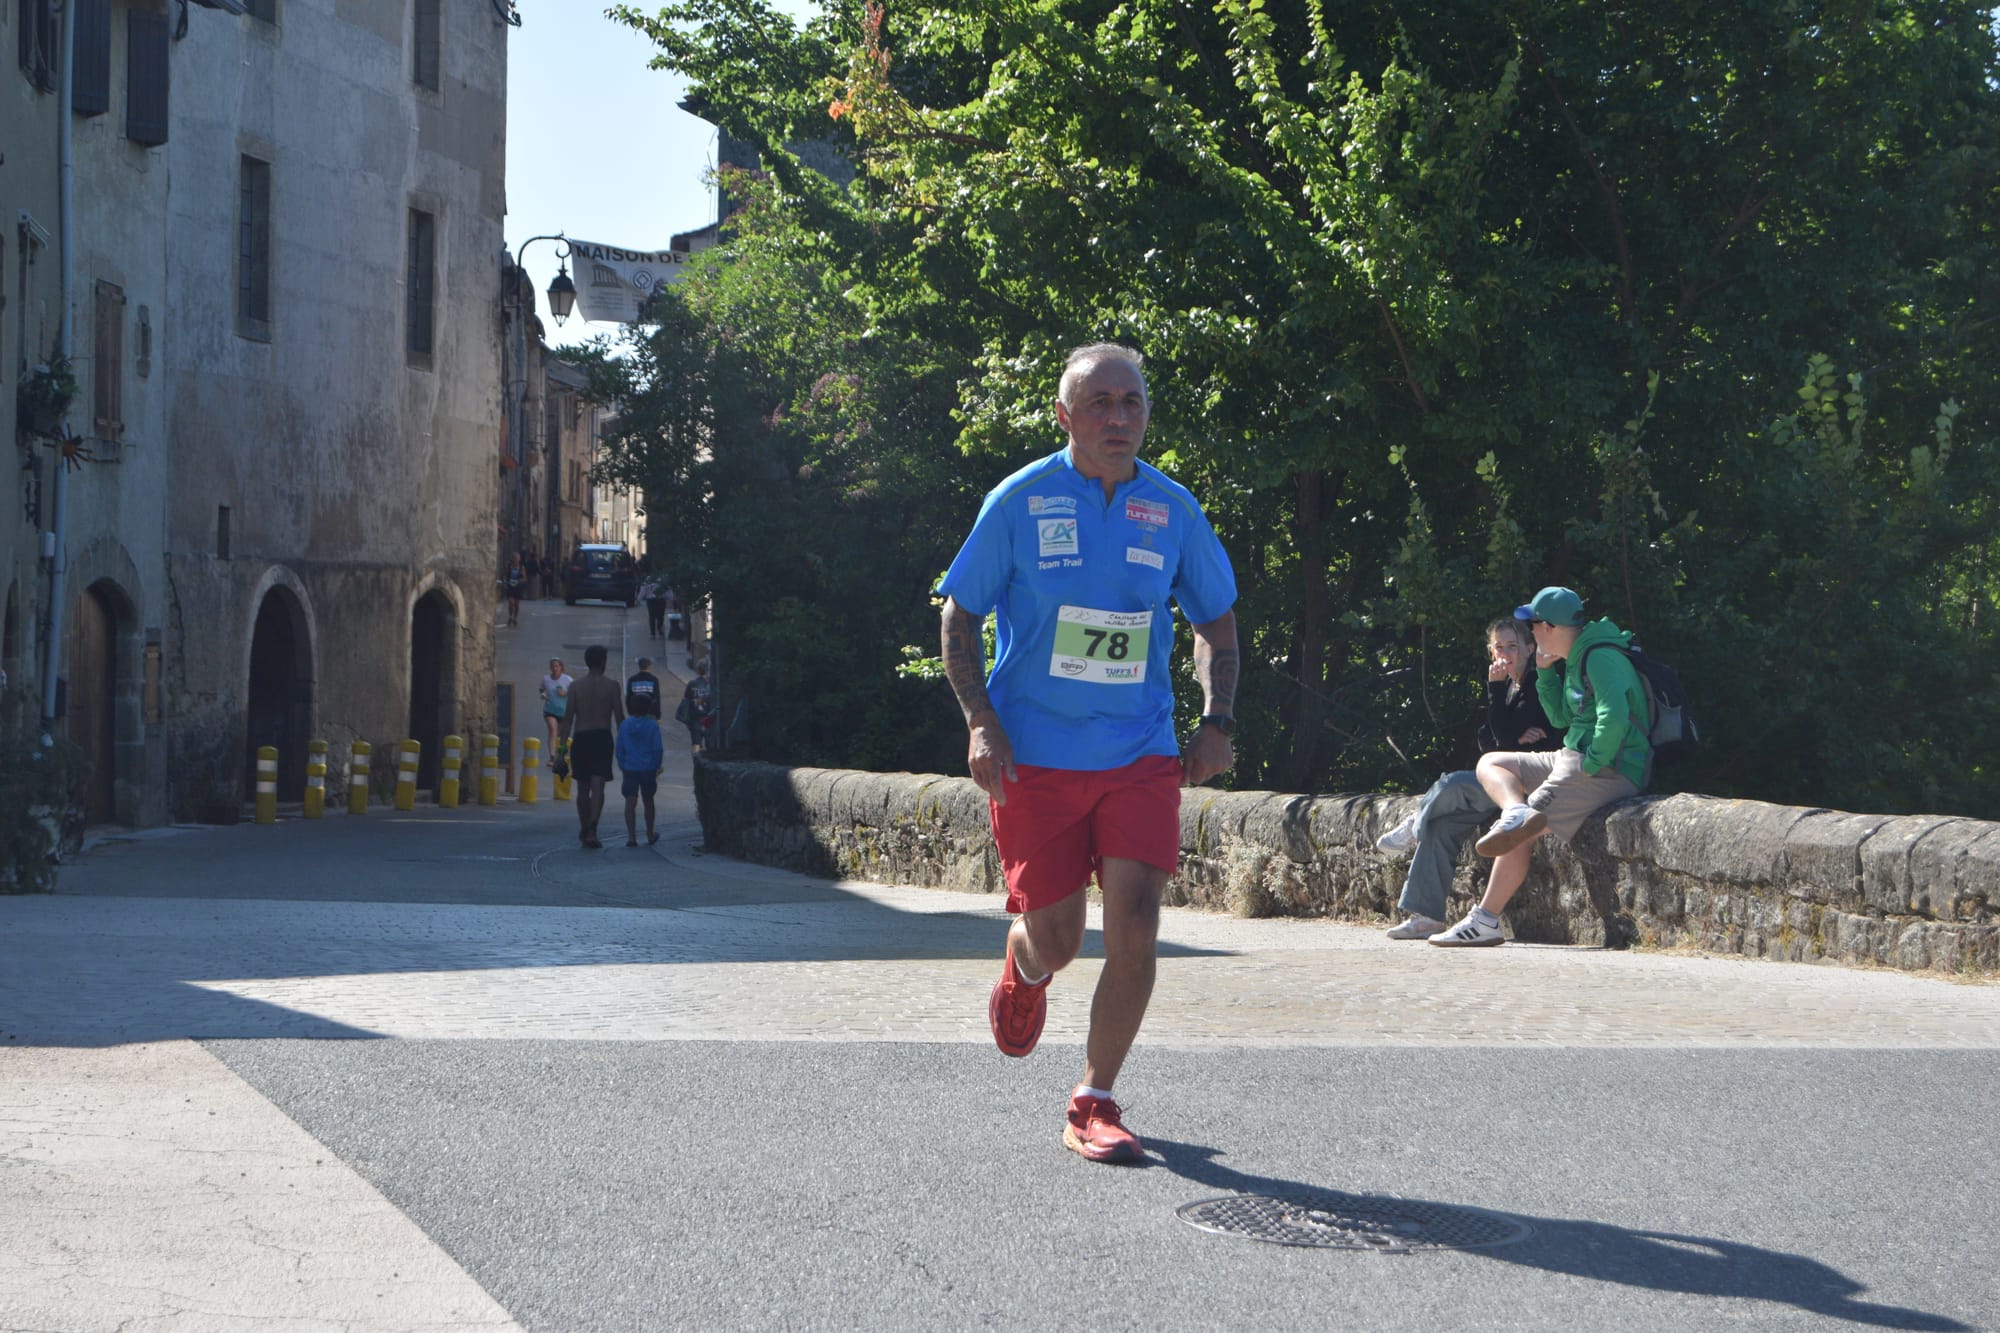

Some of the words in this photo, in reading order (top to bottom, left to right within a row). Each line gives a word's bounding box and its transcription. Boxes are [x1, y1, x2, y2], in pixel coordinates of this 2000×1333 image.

[575, 244, 653, 263] MAISON
[659, 253, 683, 264] DE
[1038, 560, 1060, 570] Team
[1062, 558, 1084, 567] Trail
[1084, 628, 1130, 661] 78
